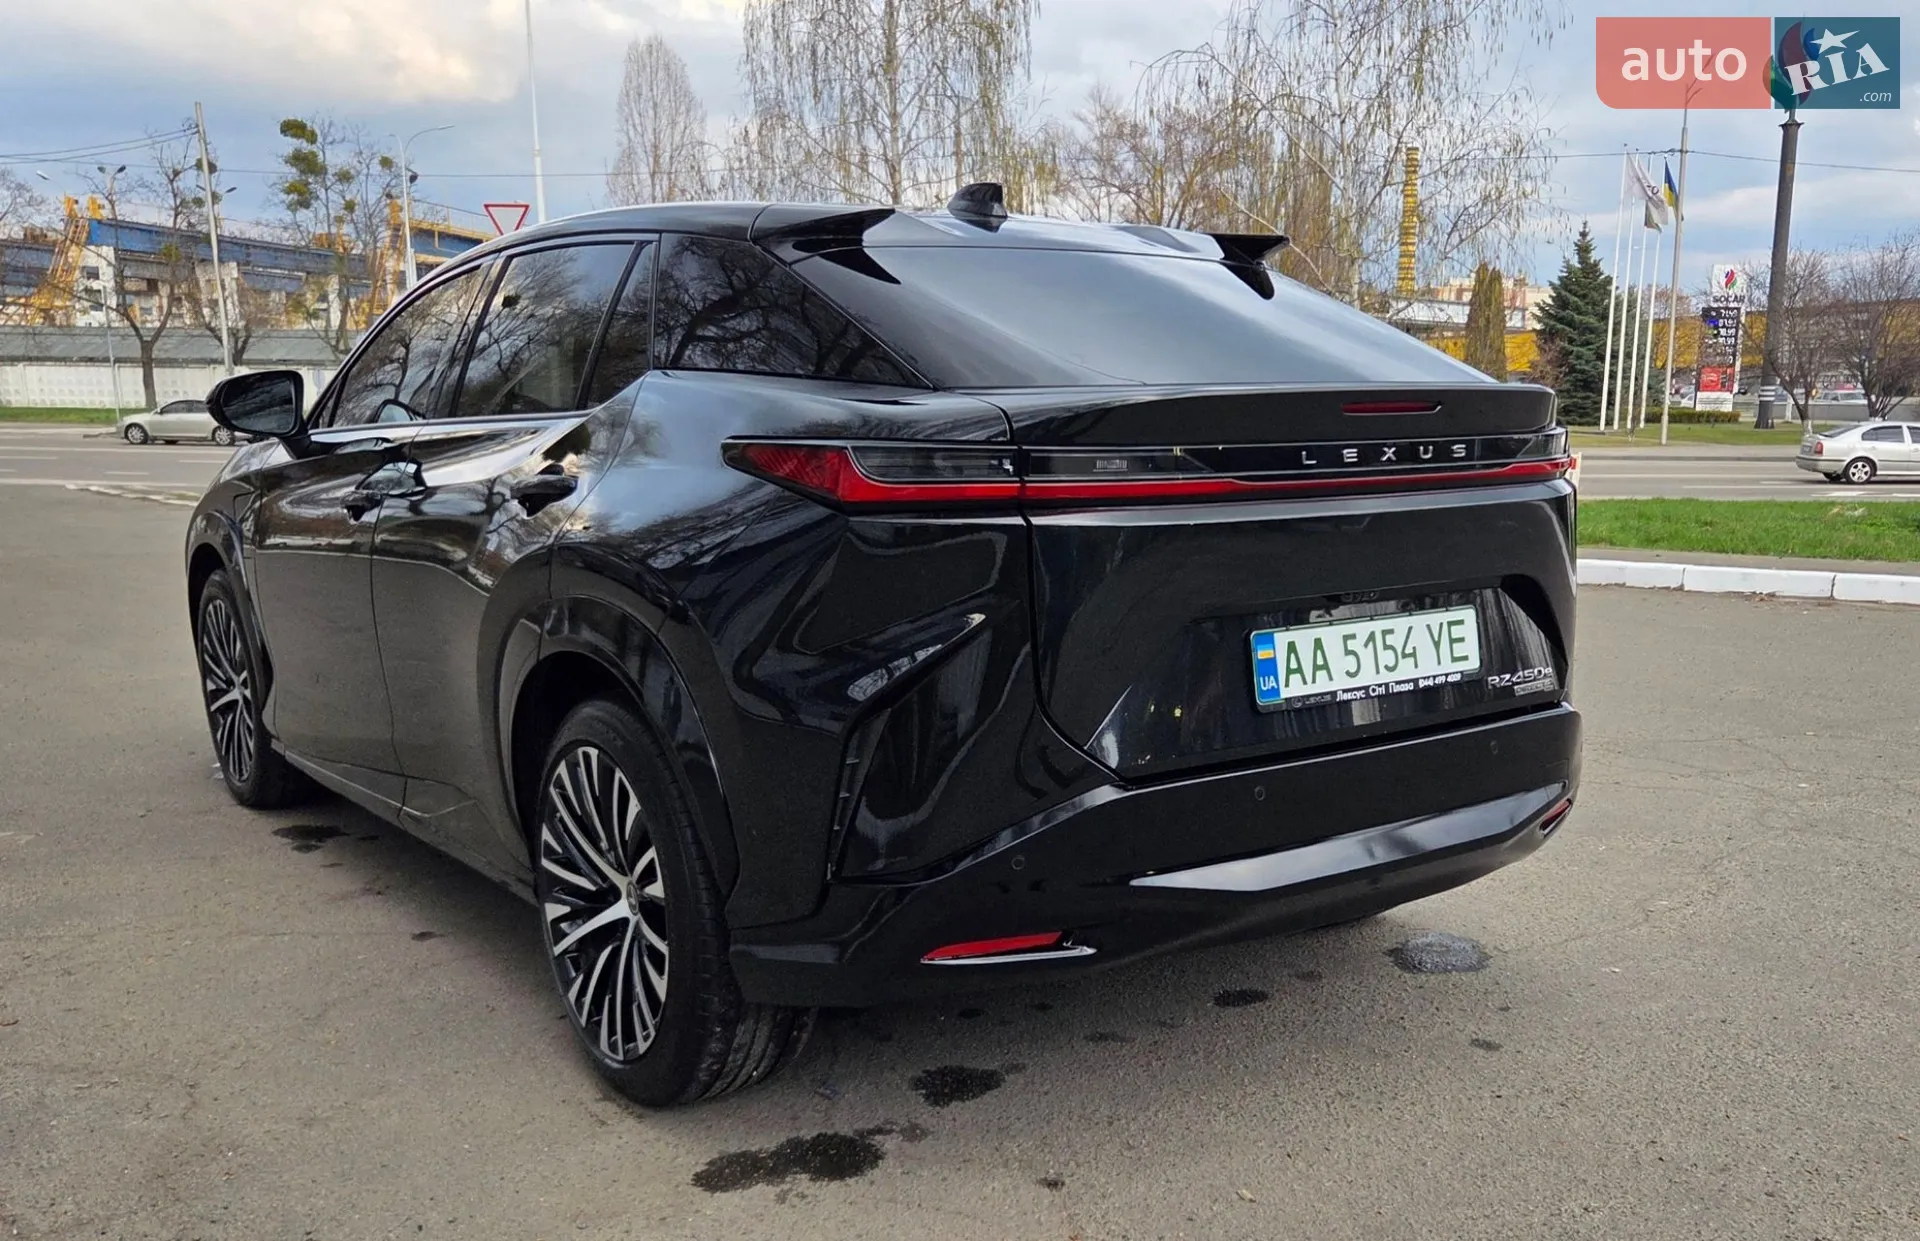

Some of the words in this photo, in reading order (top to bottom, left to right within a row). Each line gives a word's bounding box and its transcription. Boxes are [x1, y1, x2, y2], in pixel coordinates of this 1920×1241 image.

[1301, 444, 1467, 465] LEXUS
[1284, 637, 1334, 688] AA
[1342, 625, 1419, 679] 5154
[1426, 619, 1470, 666] YE
[1260, 675, 1278, 691] UA
[1487, 667, 1553, 689] RZ450e
